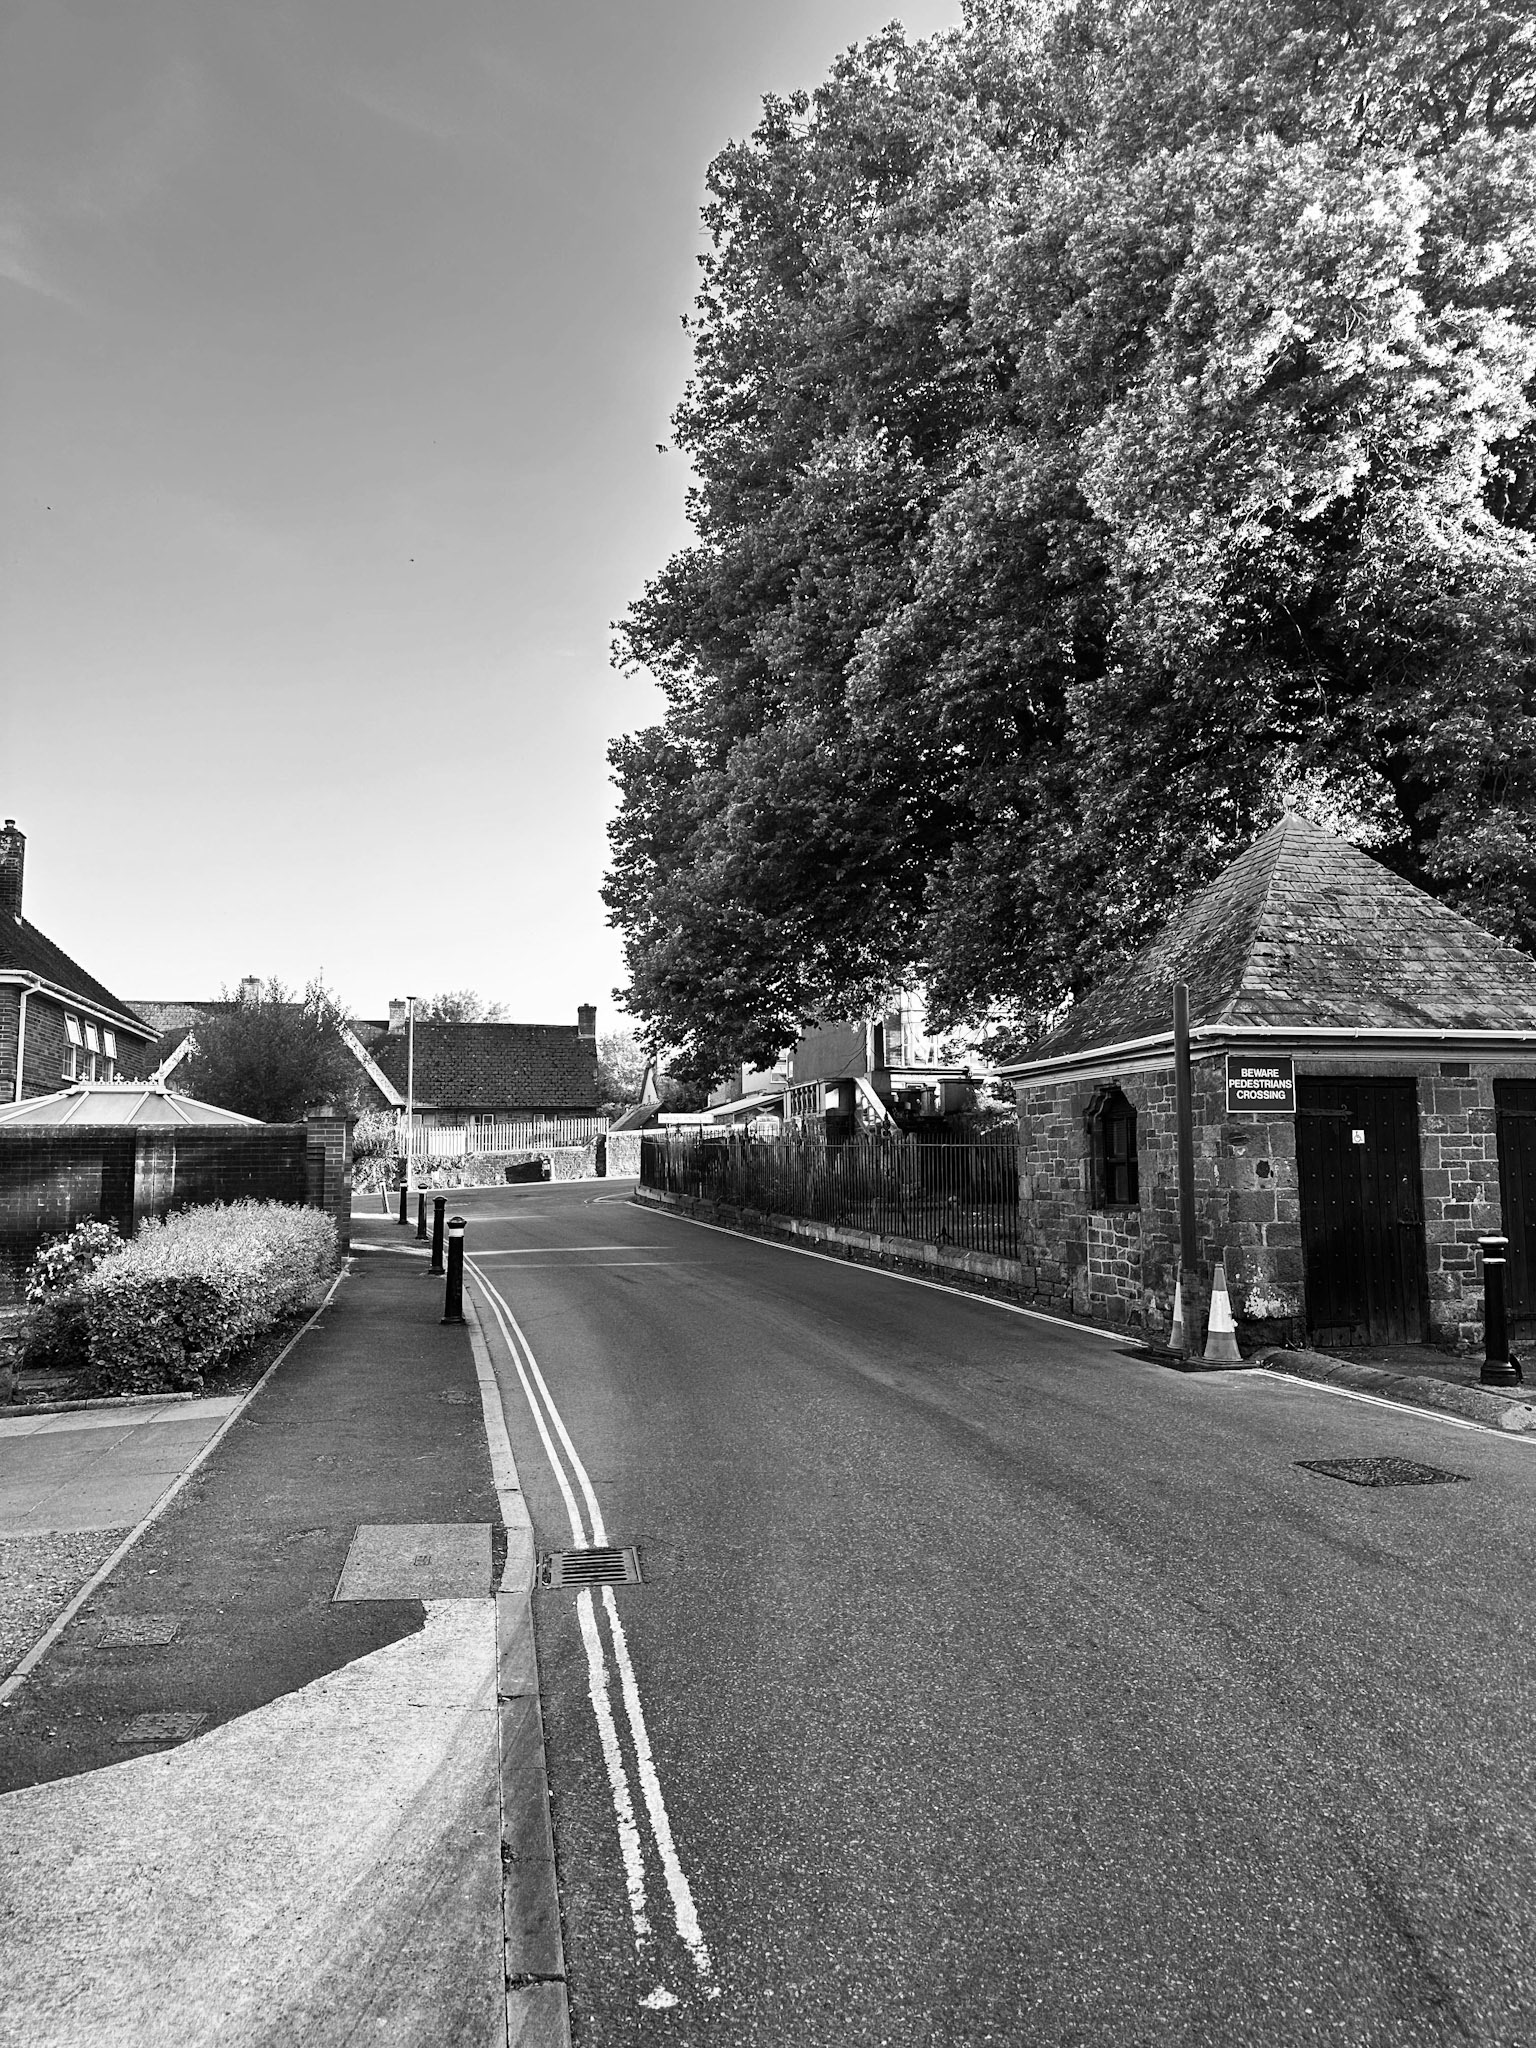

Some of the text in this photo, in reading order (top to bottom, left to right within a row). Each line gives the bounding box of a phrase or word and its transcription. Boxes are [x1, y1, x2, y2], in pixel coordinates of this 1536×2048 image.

[1241, 1068, 1279, 1077] BEWARE
[1229, 1079, 1292, 1088] PEDESTRIANS
[1236, 1090, 1286, 1099] CROSSING
